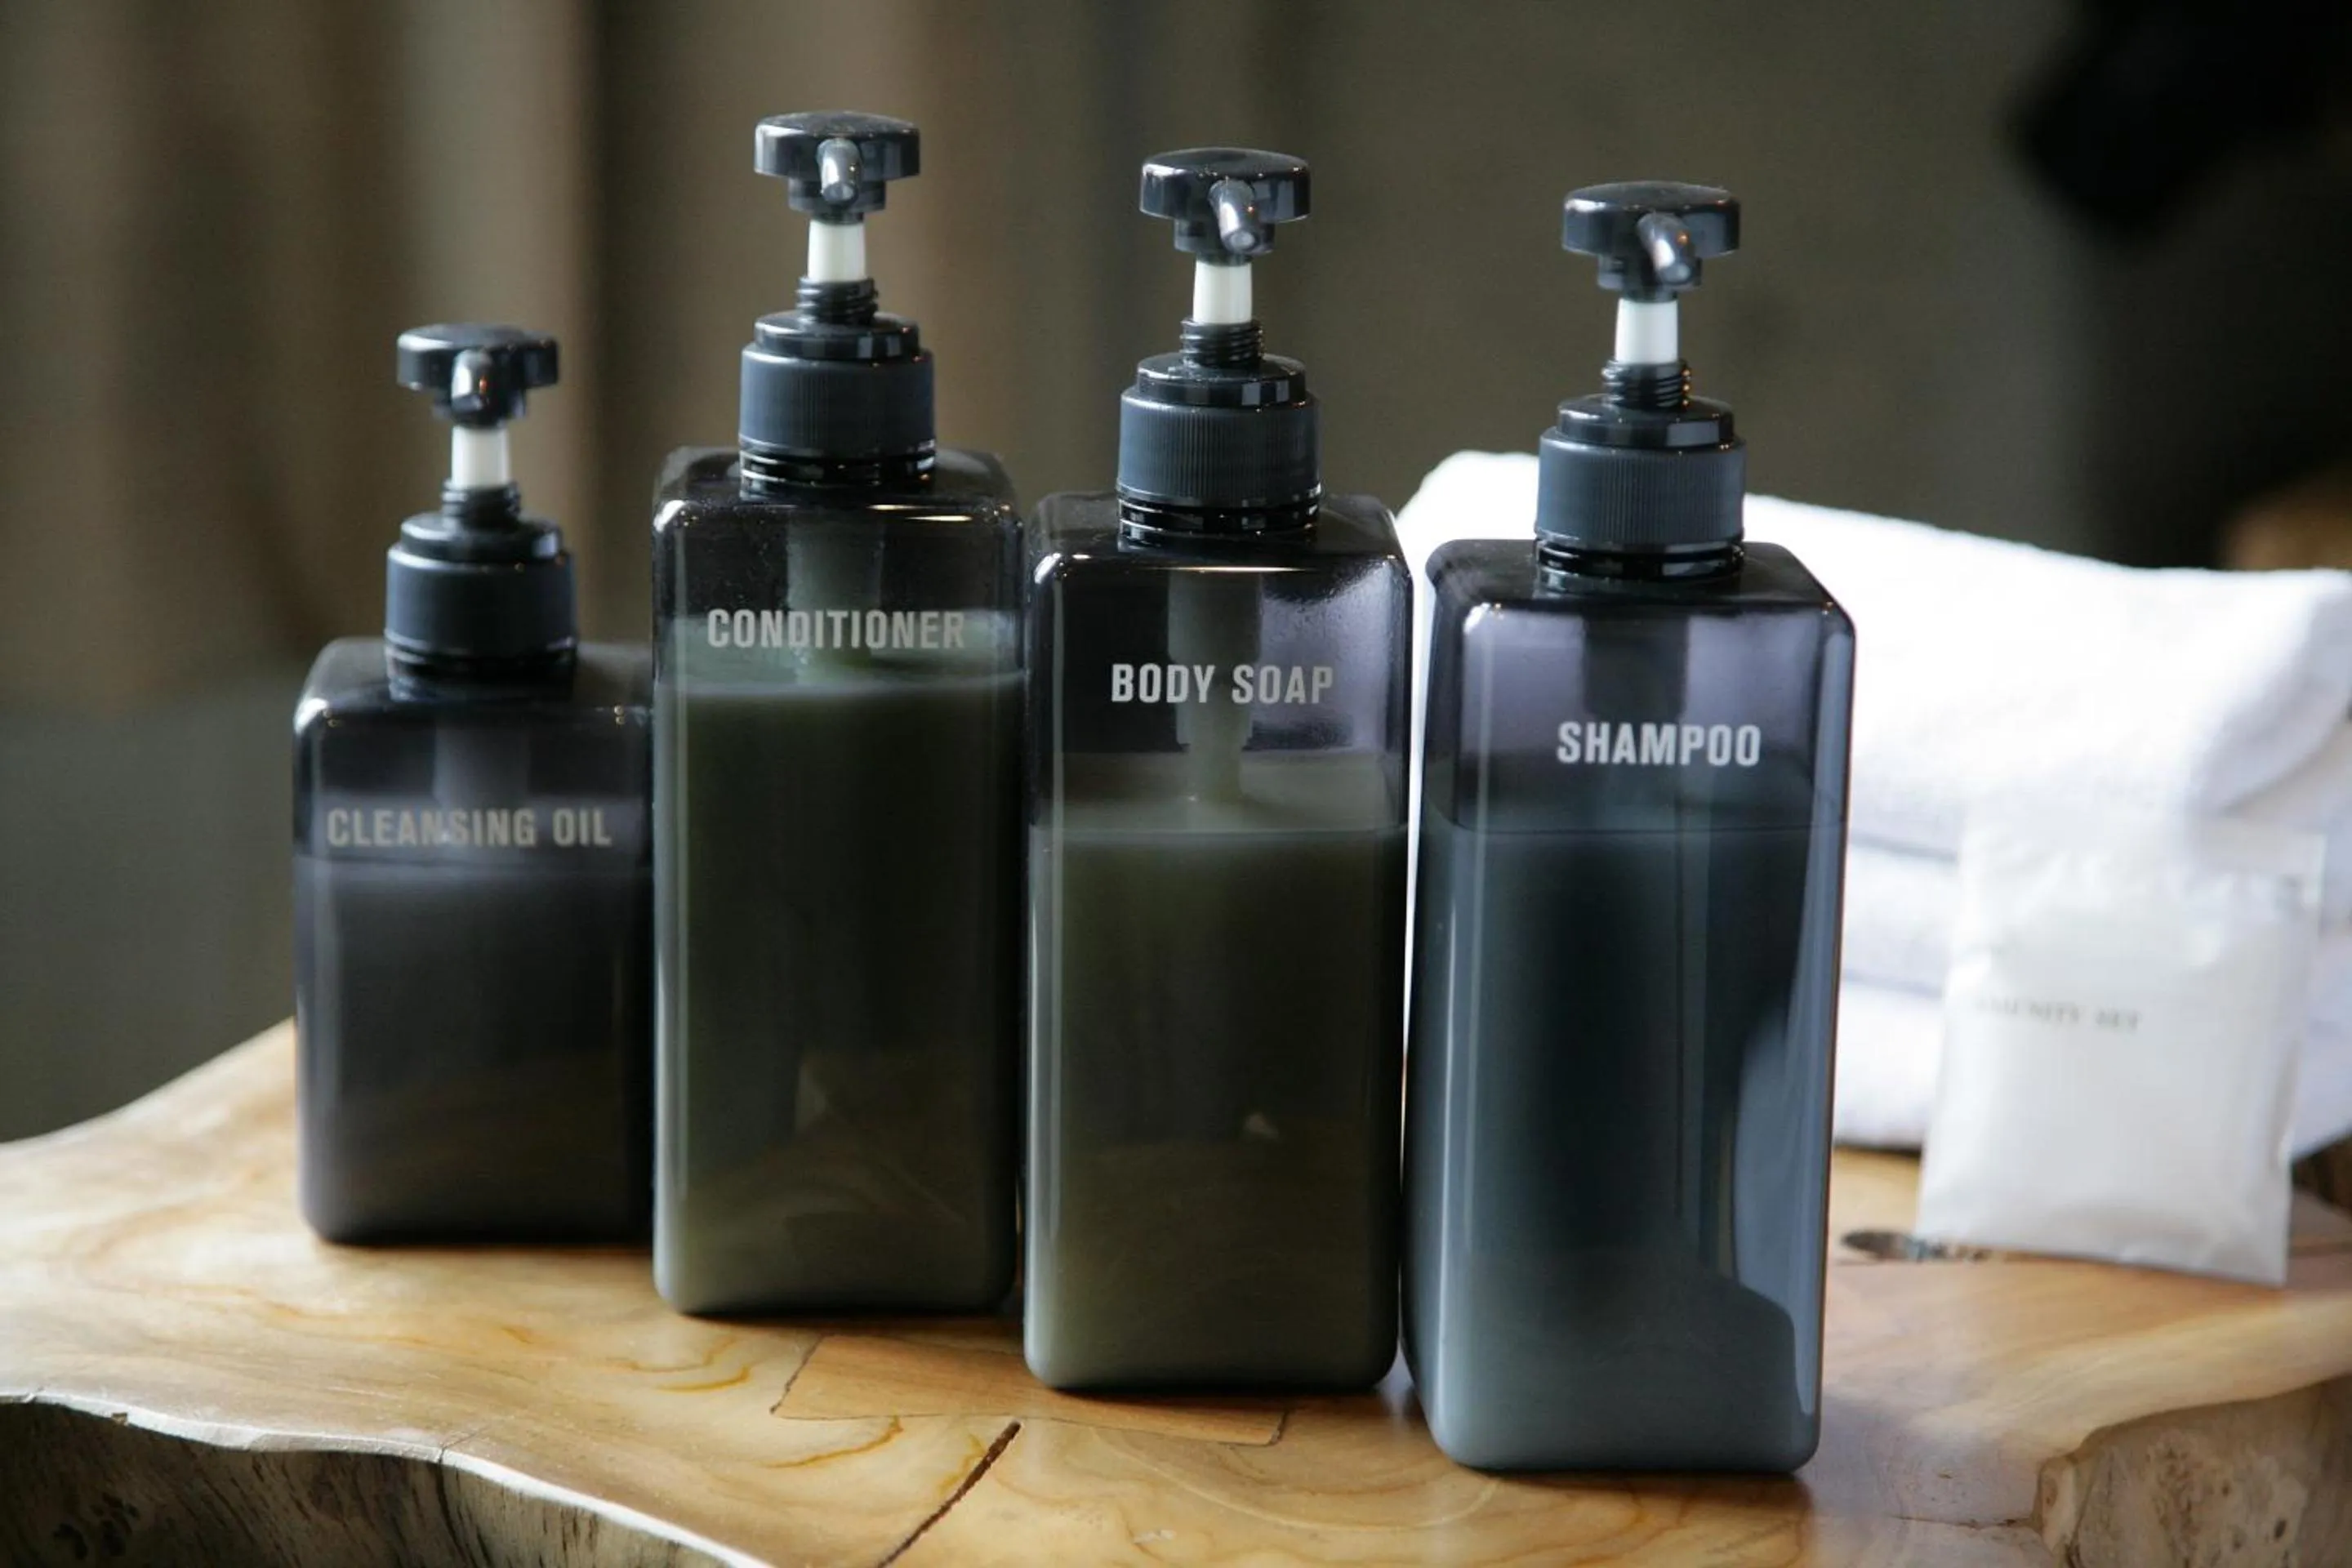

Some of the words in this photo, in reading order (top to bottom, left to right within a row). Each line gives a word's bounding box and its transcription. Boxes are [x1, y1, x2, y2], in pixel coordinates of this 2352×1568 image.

[707, 608, 965, 648] CONDITIONER
[1111, 662, 1216, 703] BODY
[1231, 664, 1333, 704] SOAP
[1557, 720, 1762, 766] SHAMPOO
[327, 807, 536, 847] CLEANSING
[552, 807, 612, 847] OIL
